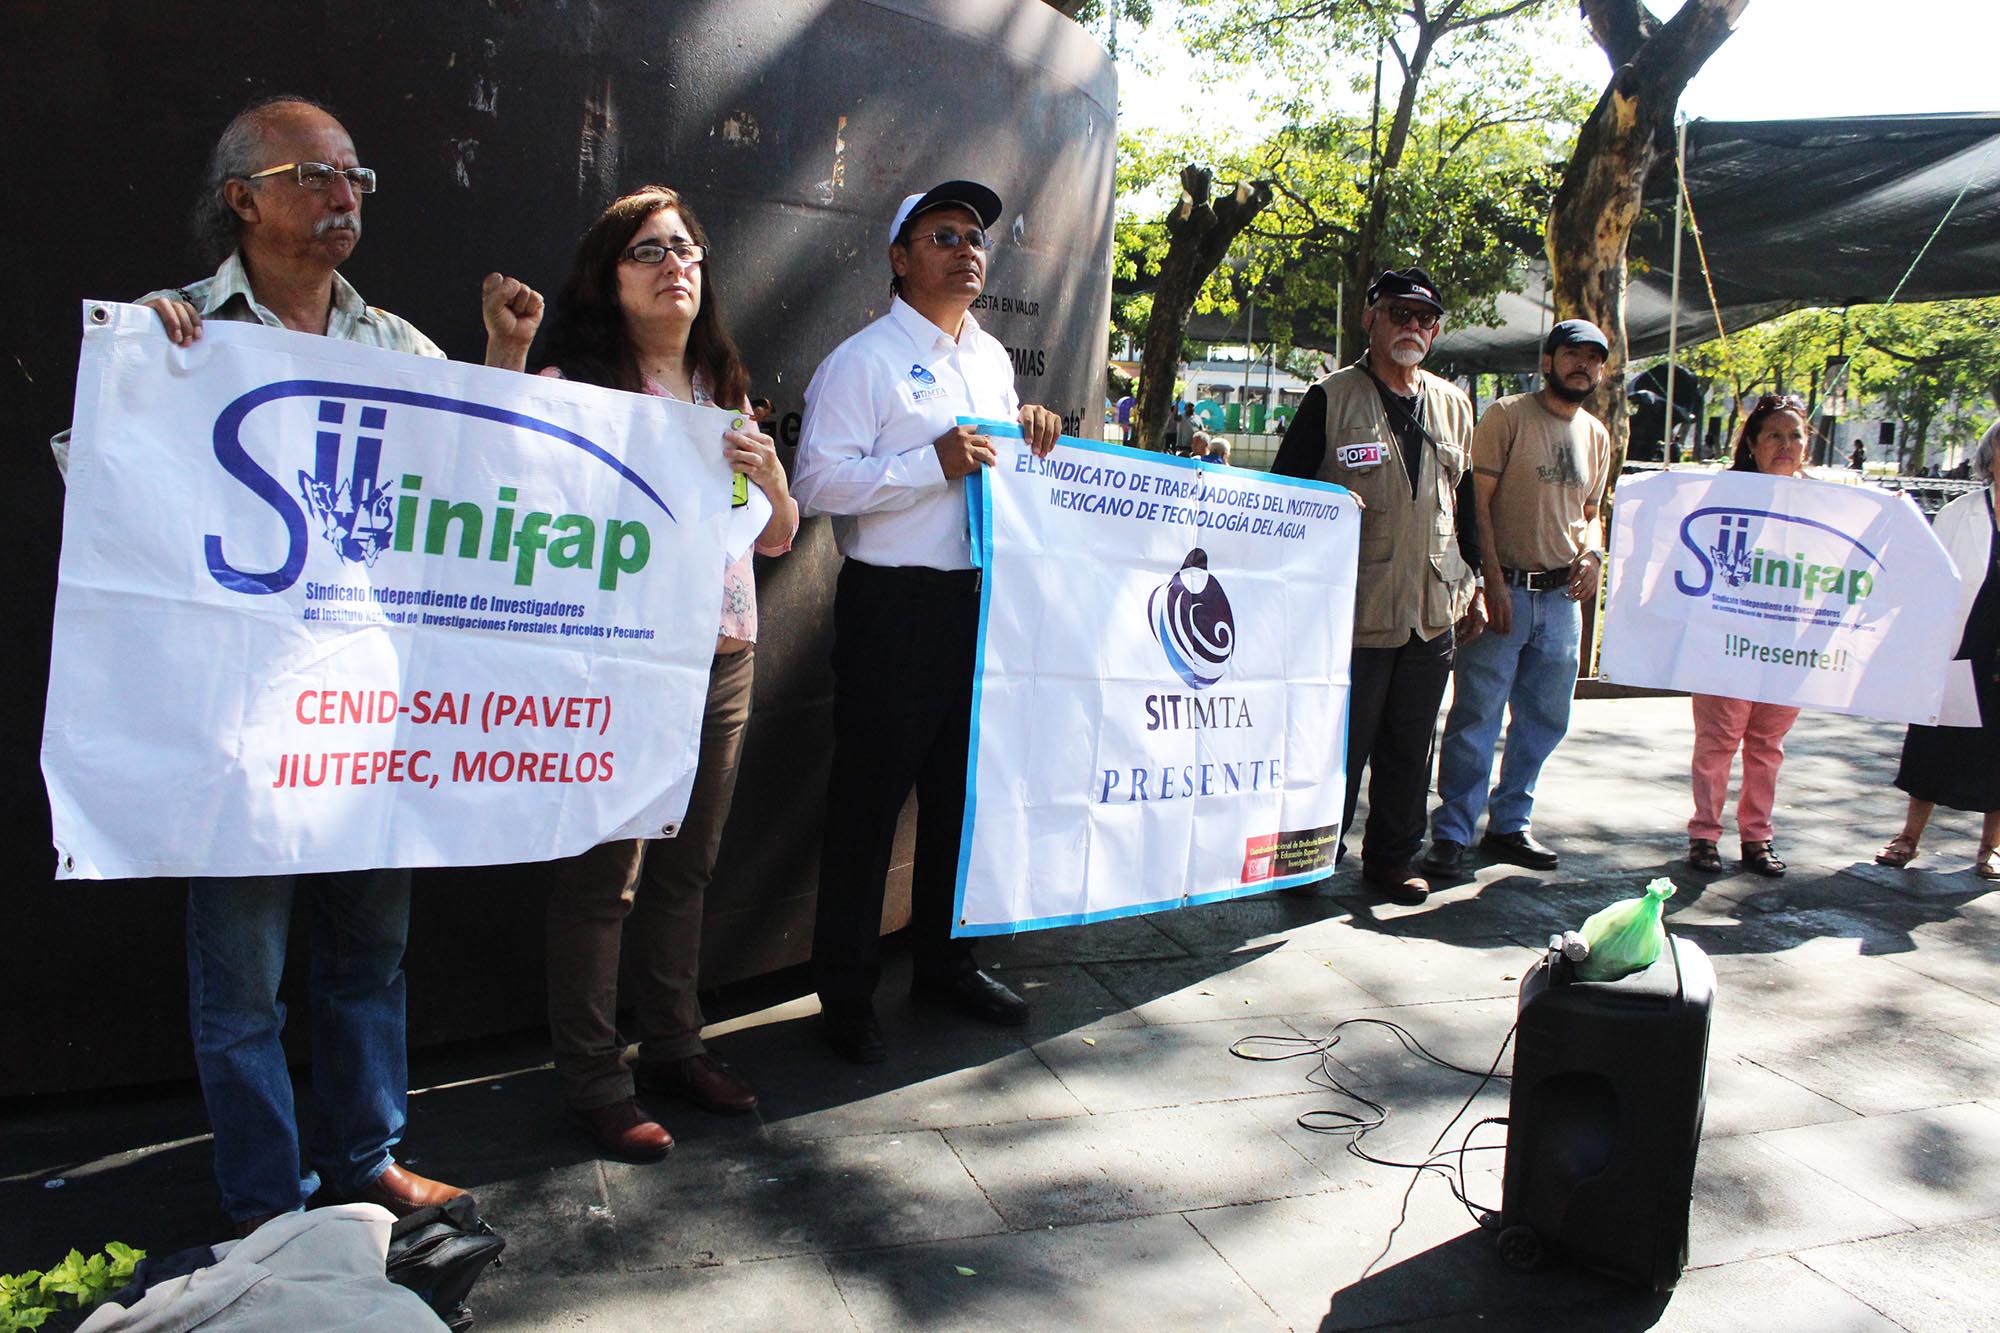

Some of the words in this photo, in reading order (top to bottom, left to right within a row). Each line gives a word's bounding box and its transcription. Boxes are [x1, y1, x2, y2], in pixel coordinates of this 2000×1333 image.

[1001, 298, 1013, 313] EN
[1347, 447, 1378, 461] OPT
[1015, 454, 1037, 474] EL
[1038, 457, 1127, 489] SINDICATO
[1128, 473, 1152, 493] DE
[1154, 477, 1260, 509] TRABAJADORES
[1262, 495, 1285, 513] DEL
[1286, 499, 1339, 521] INSTITUTO
[1050, 487, 1134, 518] MEXICANO
[1135, 501, 1158, 521] DE
[1161, 505, 1249, 533] TECNOLOGÍA
[1250, 517, 1274, 536] DEL
[1274, 521, 1306, 540] AGUA
[305, 582, 365, 602] Sindicato
[369, 587, 467, 610] Independiente
[470, 594, 488, 611] de
[490, 596, 585, 618] Investigadores
[303, 607, 320, 621] del
[321, 608, 363, 623] Instituto
[406, 612, 418, 625] de
[421, 612, 506, 632] Investigaciones
[605, 627, 612, 639] y
[613, 626, 655, 640] Pecuarias
[1725, 633, 1848, 672] !!Presente!!
[295, 691, 471, 725] CENID-SAI
[481, 691, 612, 735] (PAVET)
[1145, 695, 1253, 731] SITIMTA
[272, 750, 439, 789] JIUTEPEC,
[452, 751, 615, 783] MORELOS
[1099, 759, 1281, 804] PRESENTE
